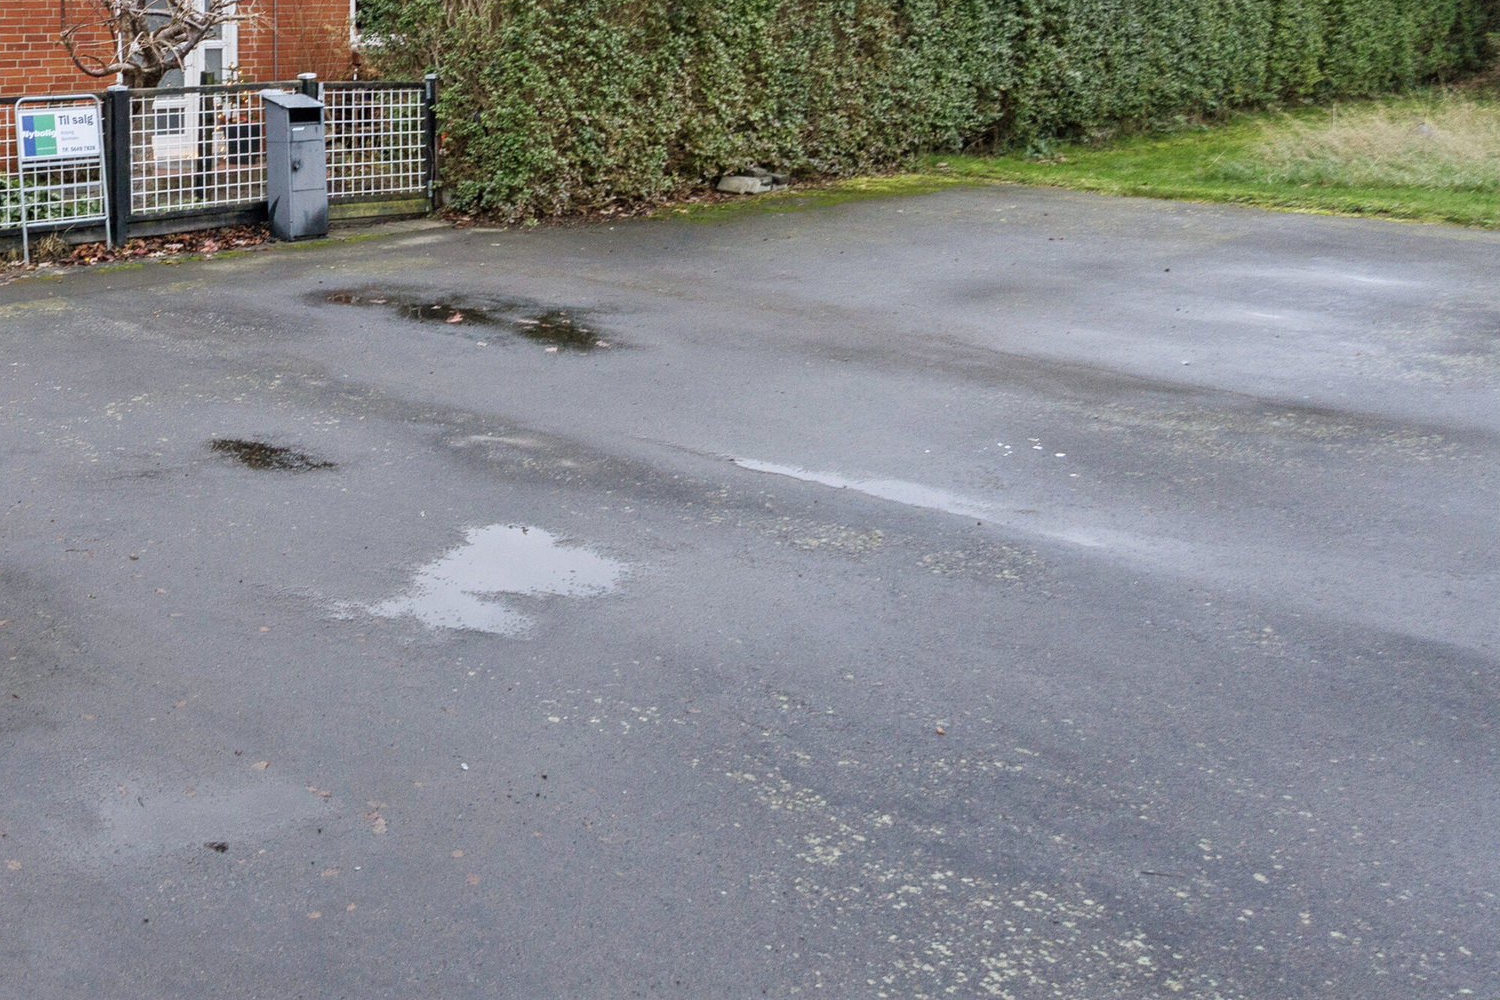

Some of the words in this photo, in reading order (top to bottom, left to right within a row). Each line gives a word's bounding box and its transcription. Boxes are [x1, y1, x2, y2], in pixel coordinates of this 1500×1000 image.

[58, 115, 70, 125] Til
[72, 114, 94, 126] salg
[22, 129, 56, 140] Nybolig
